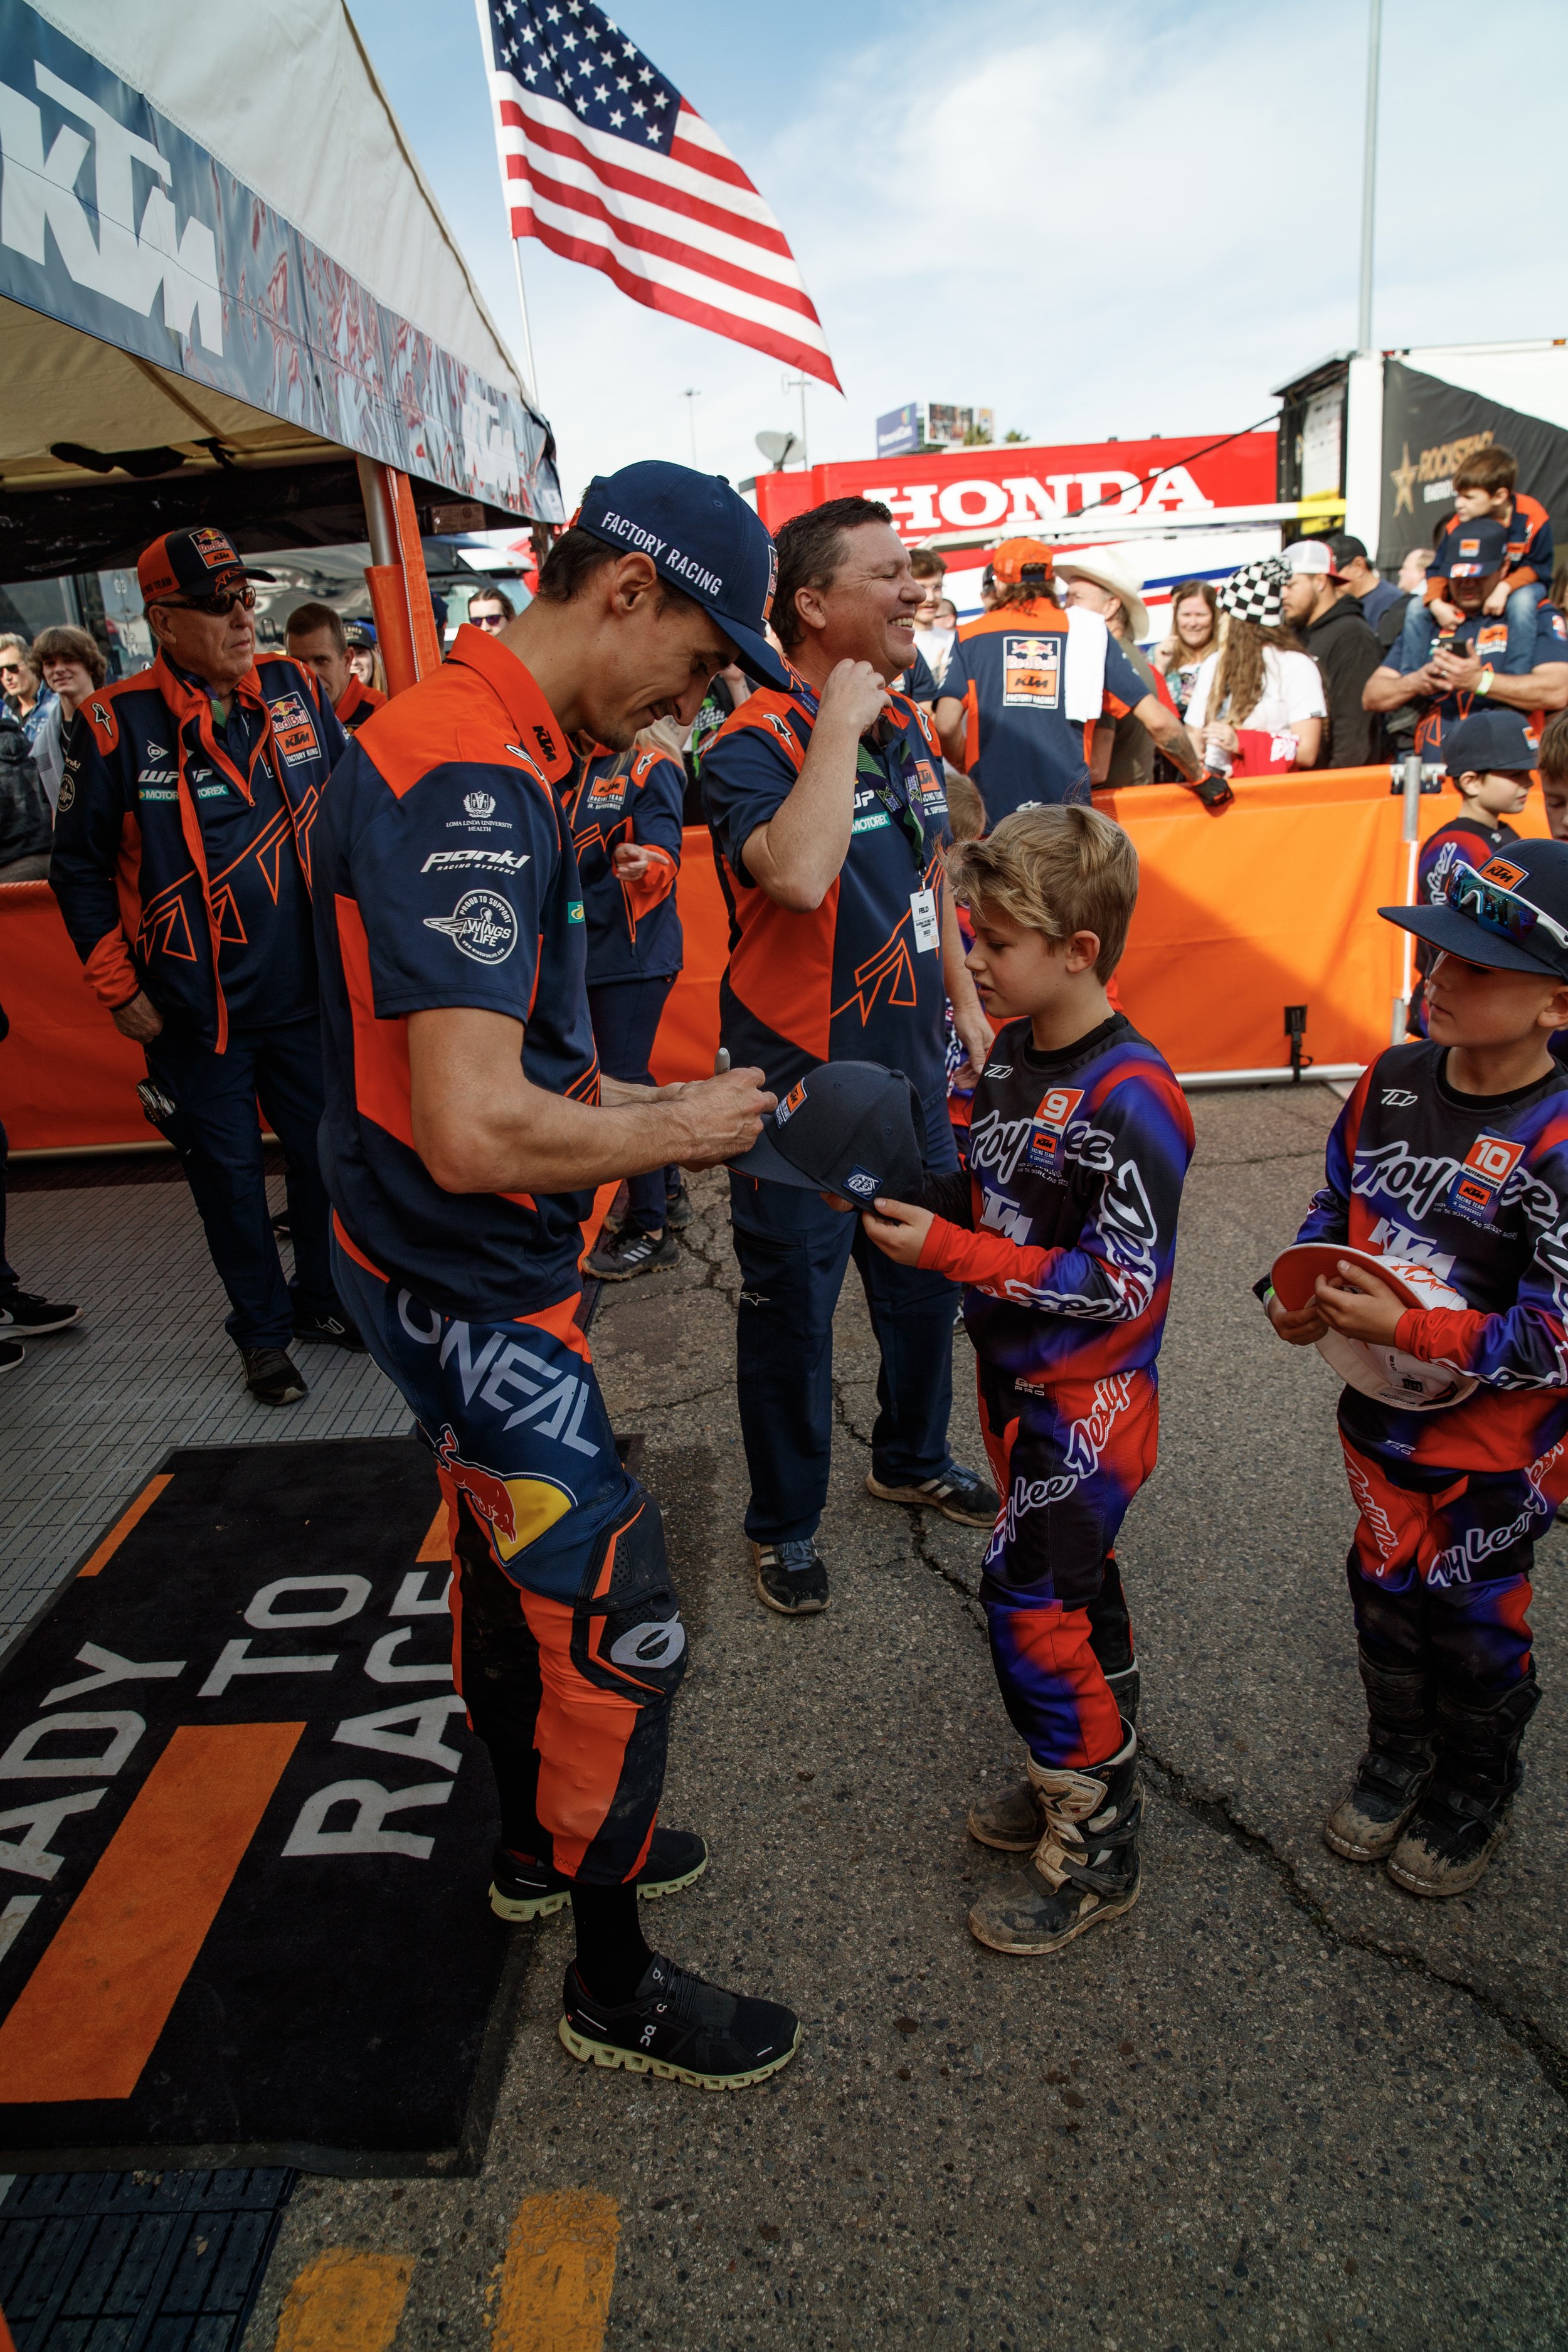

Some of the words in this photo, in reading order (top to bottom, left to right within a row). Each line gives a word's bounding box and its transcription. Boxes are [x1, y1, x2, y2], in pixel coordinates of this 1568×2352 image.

[0, 59, 223, 358] KTM
[462, 388, 520, 495] KTM
[863, 466, 1214, 531] HONDA
[213, 553, 230, 561] KTM
[600, 511, 667, 557] FACTORY
[665, 548, 723, 596] RACING
[154, 576, 172, 590] TEAM
[1015, 675, 1049, 687] KTM
[272, 716, 291, 733] Red
[289, 709, 309, 726] Bull
[285, 731, 309, 748] KTM
[532, 726, 557, 762] KTM
[287, 751, 306, 763] FACTORY
[138, 769, 179, 783] WP
[146, 790, 179, 799] MOTOR
[480, 820, 512, 829] UNIVERSITY
[437, 863, 471, 871] RACING
[474, 864, 516, 876] SYSTEMS
[1486, 865, 1514, 883] KTM
[459, 896, 479, 915] PROUD
[488, 898, 512, 923] SUPPORT
[467, 919, 512, 939] WINGS
[472, 931, 498, 947] LIFE
[1043, 1093, 1069, 1120] 9
[1382, 1088, 1419, 1107] TLD
[1030, 1147, 1044, 1156] RACING
[1036, 1137, 1054, 1149] KTM
[1066, 1120, 1115, 1171] ee
[1034, 1156, 1054, 1166] SUPERCROSS
[1475, 1141, 1511, 1175] 10
[1350, 1140, 1462, 1221] Troy
[1463, 1186, 1486, 1200] KTM
[1455, 1194, 1472, 1205] RACING
[1472, 1200, 1485, 1211] TEAM
[1458, 1203, 1483, 1217] SUPERCROSS
[979, 1187, 1033, 1246] TM
[1368, 1217, 1456, 1280] KTM
[1014, 1385, 1045, 1397] PRO
[1014, 1475, 1079, 1518] Lee
[196, 1574, 373, 1697] TO
[280, 1570, 467, 1860] RACE
